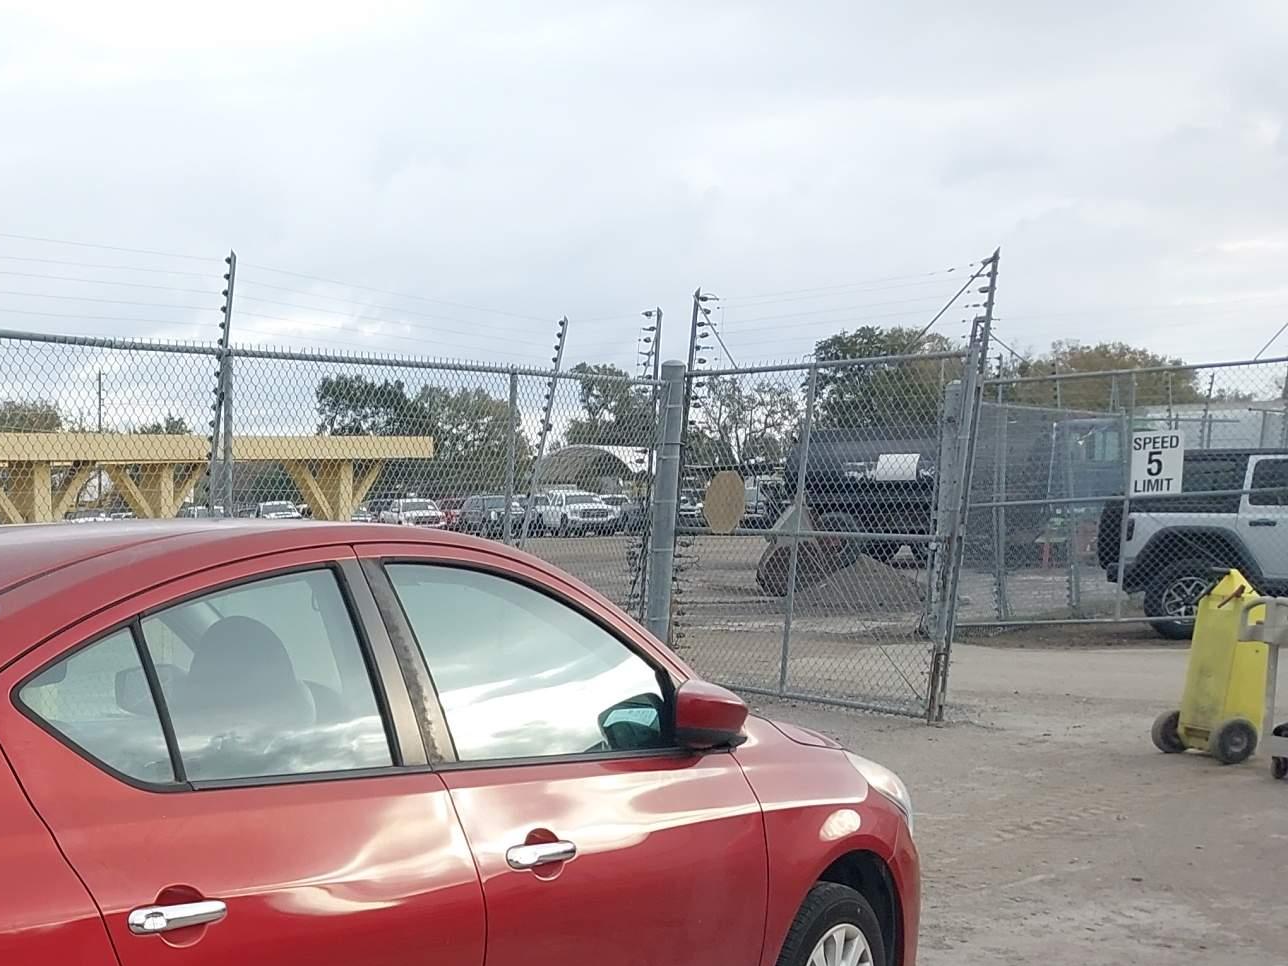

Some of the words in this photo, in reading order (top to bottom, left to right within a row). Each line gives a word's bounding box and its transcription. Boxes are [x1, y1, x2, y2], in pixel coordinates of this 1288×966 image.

[1133, 435, 1179, 450] SPEED
[1147, 451, 1162, 476] 5
[1134, 478, 1173, 492] LIMIT
